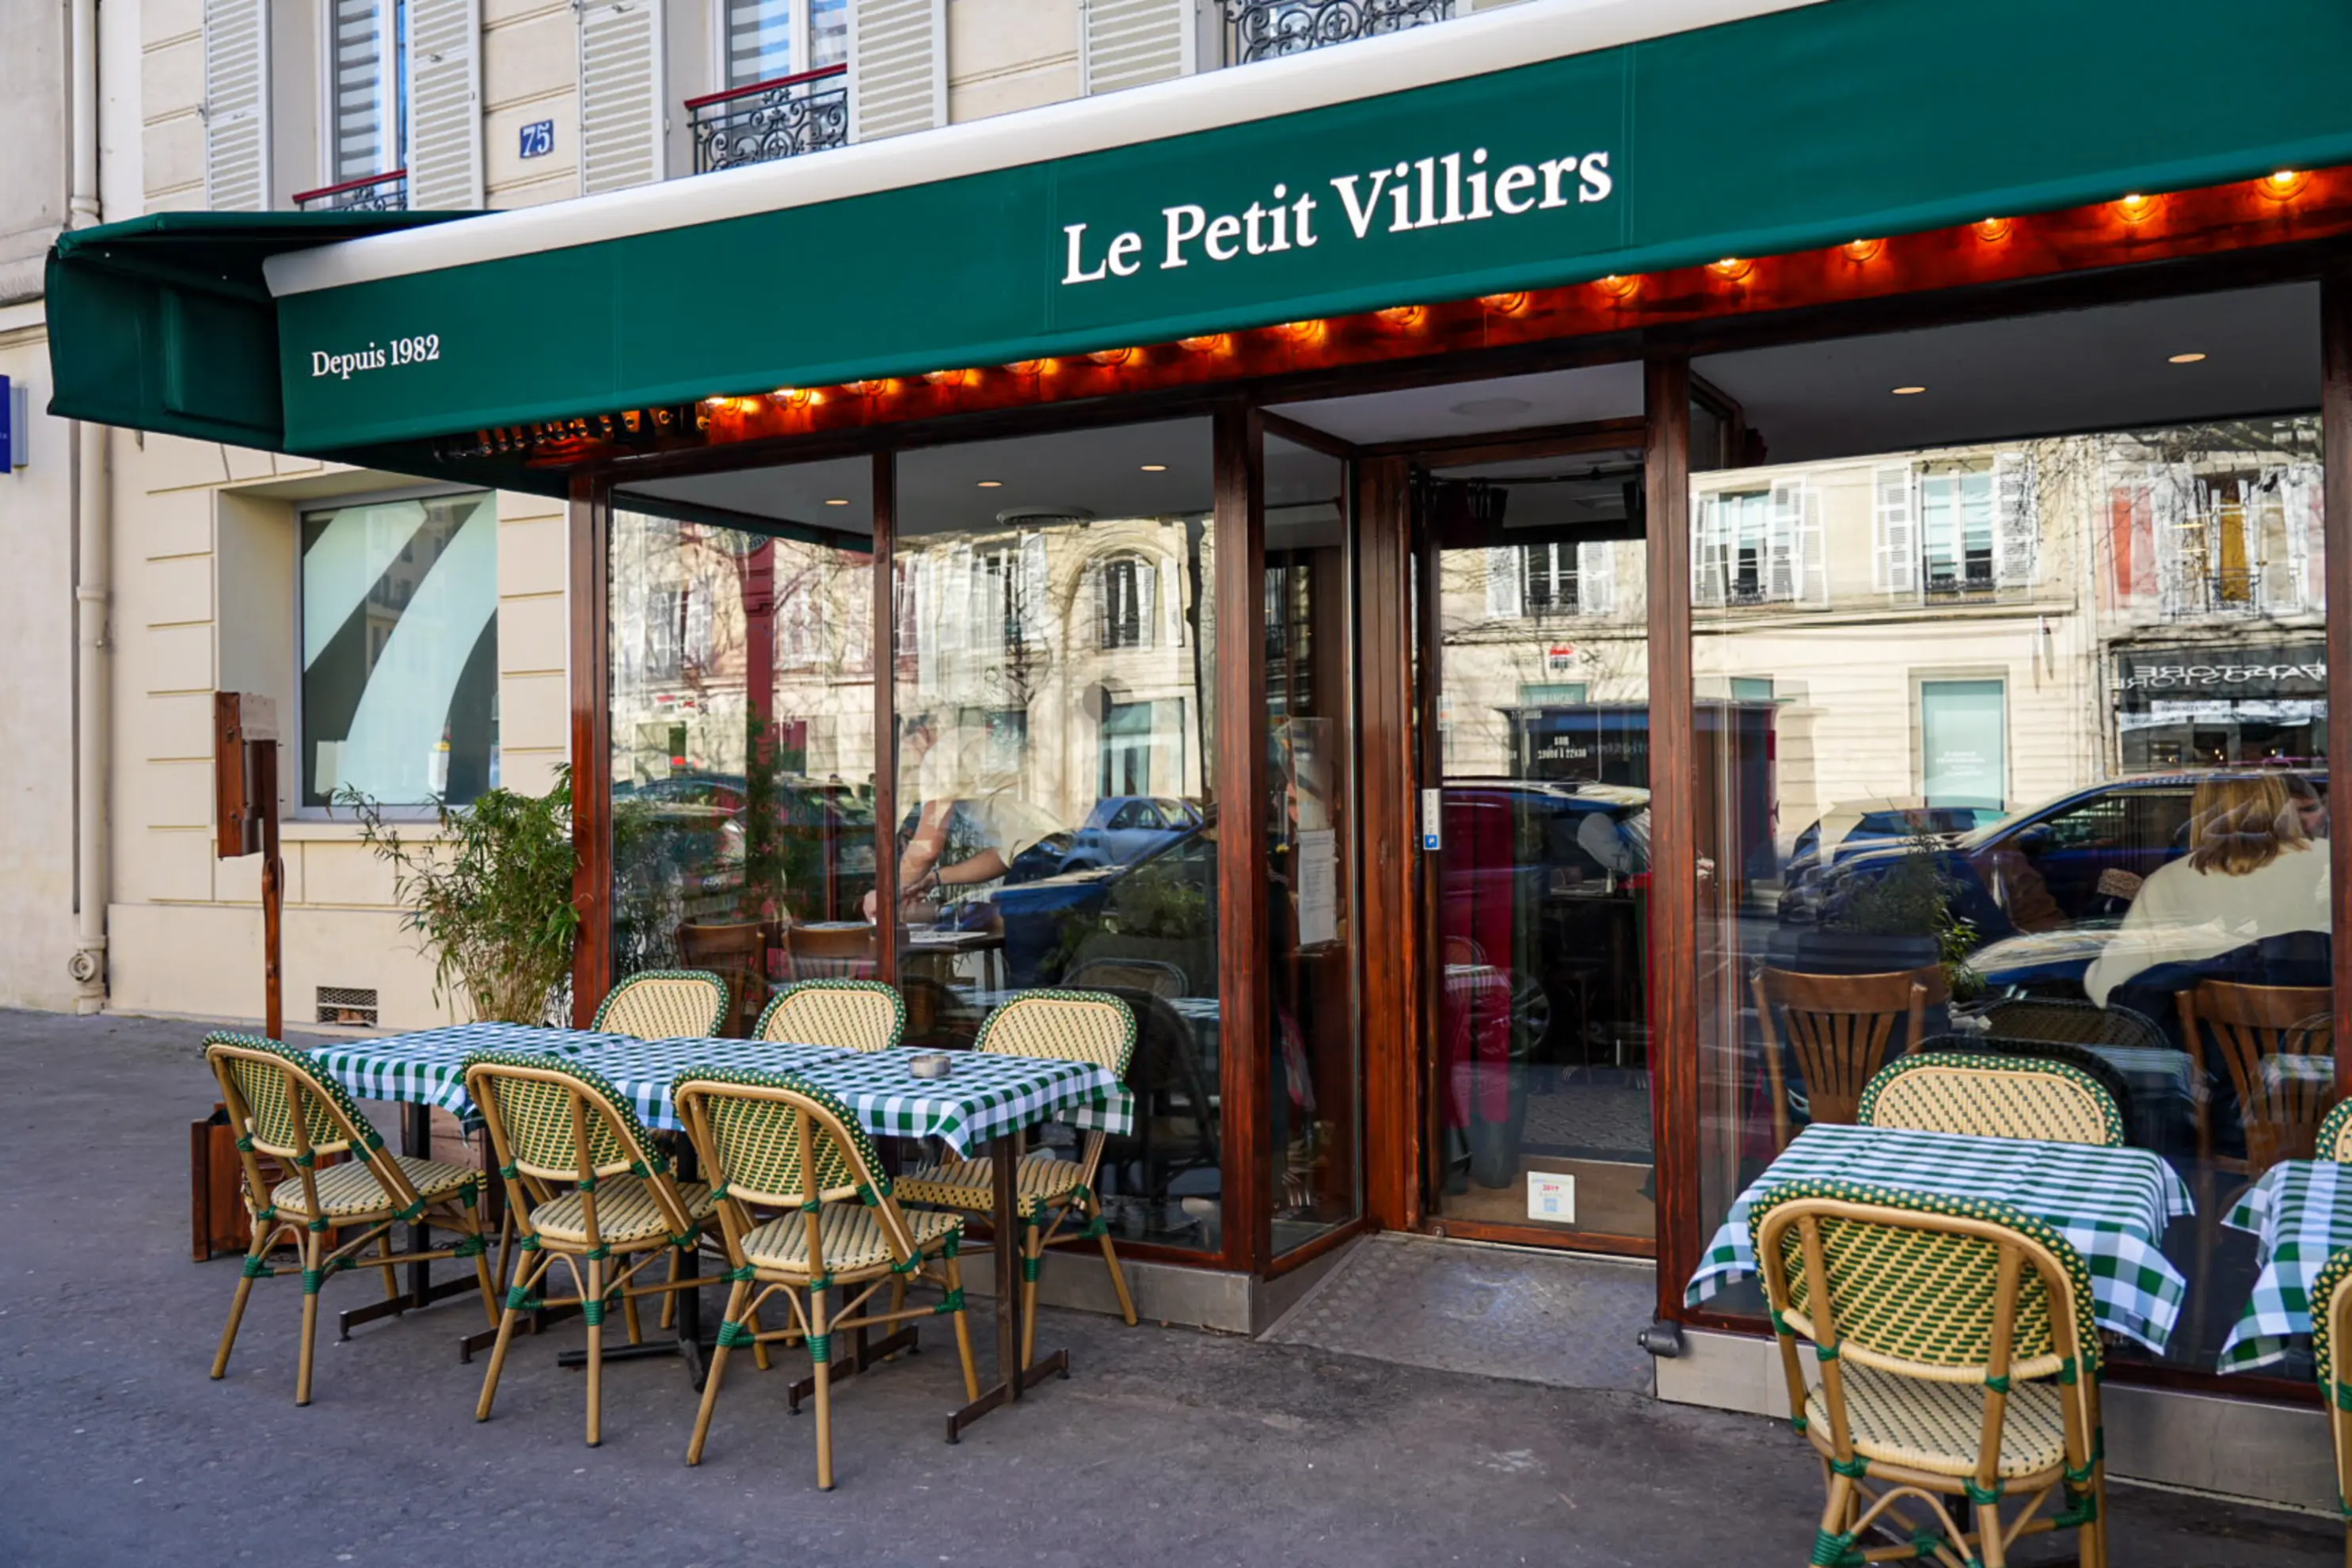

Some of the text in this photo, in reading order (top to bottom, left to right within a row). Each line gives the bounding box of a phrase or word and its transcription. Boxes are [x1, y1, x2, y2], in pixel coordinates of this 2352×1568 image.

[523, 122, 550, 156] 75
[1061, 147, 1614, 285] Le Petit Villiers
[311, 333, 440, 380] Depuis 1982
